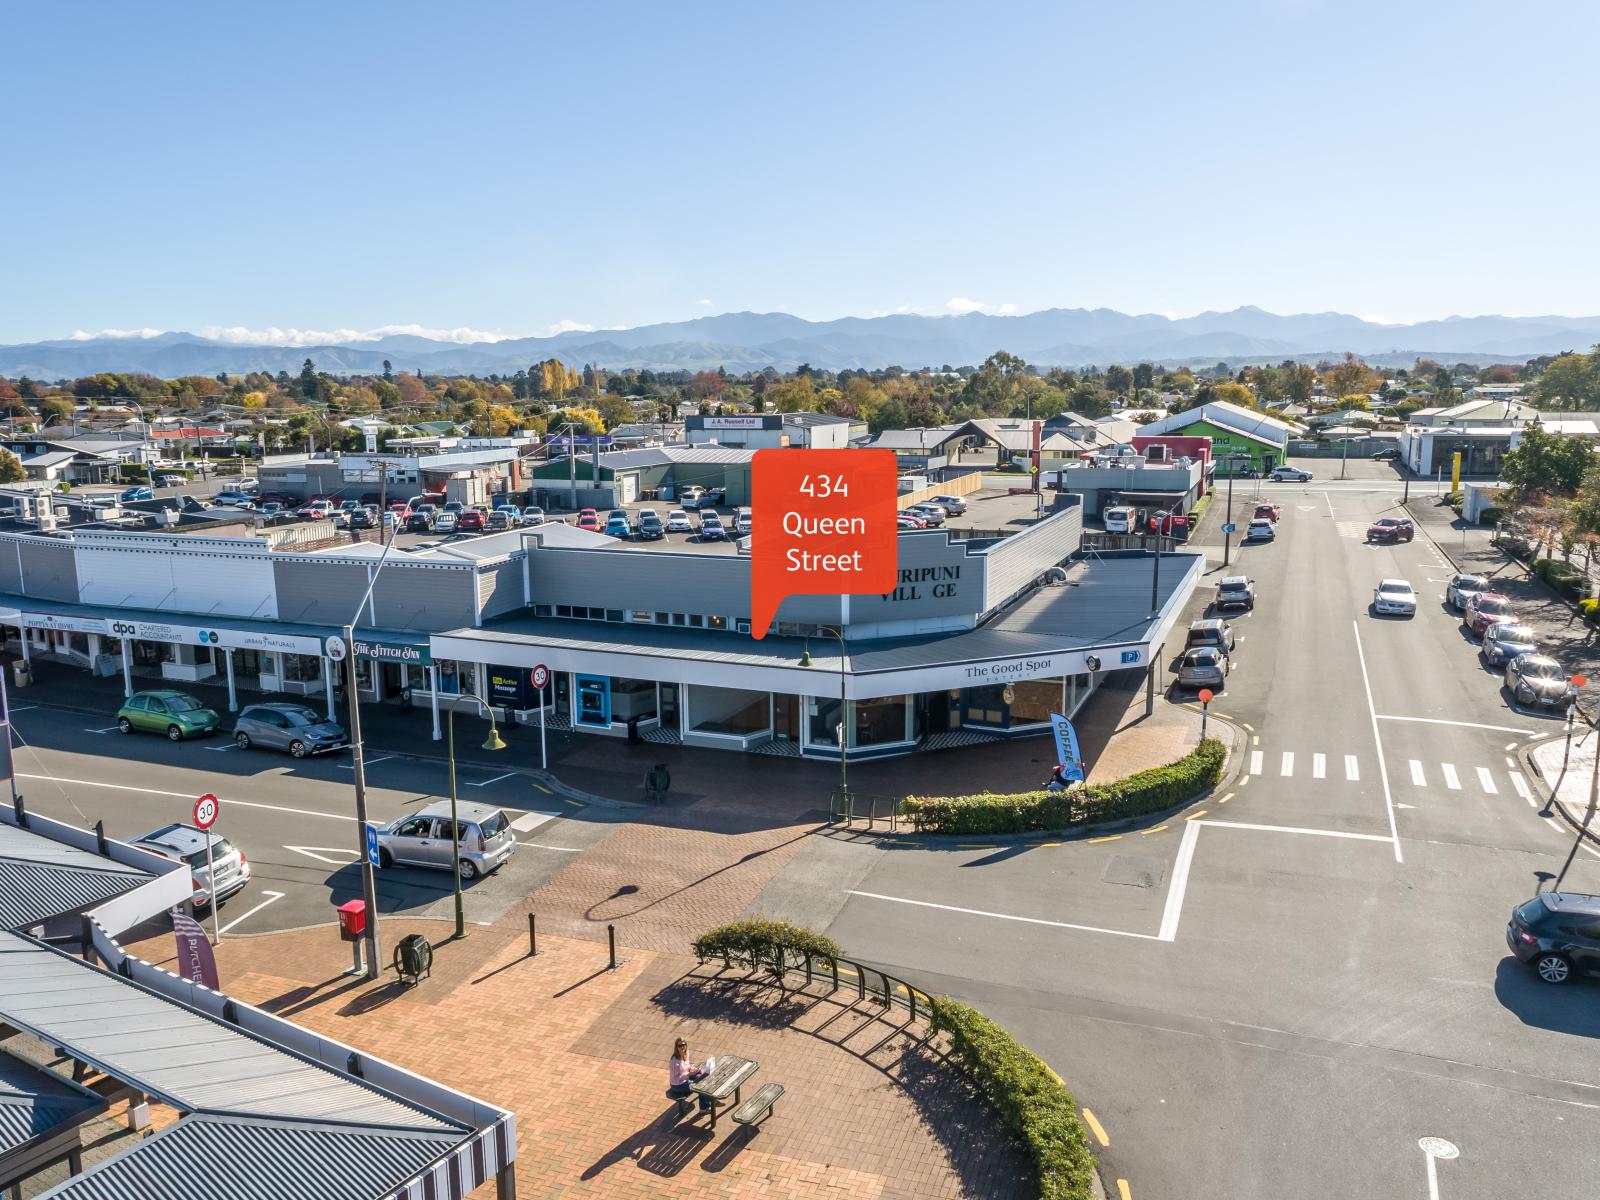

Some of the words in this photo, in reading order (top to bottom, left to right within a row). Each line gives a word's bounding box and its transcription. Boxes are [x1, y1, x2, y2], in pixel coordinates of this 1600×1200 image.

[113, 621, 136, 636] dpa
[139, 623, 171, 633] CHARTERED
[140, 631, 183, 641] ACCOUNTANTS
[267, 640, 296, 649] NATURALS
[353, 641, 370, 656] THE
[370, 643, 401, 658] STITCH
[402, 646, 420, 660] INN
[535, 670, 545, 682] 30
[965, 667, 988, 678] The
[991, 660, 1023, 674] Good
[1026, 659, 1051, 672] Spot
[1057, 721, 1074, 763] COFFEE
[199, 803, 214, 821] 30
